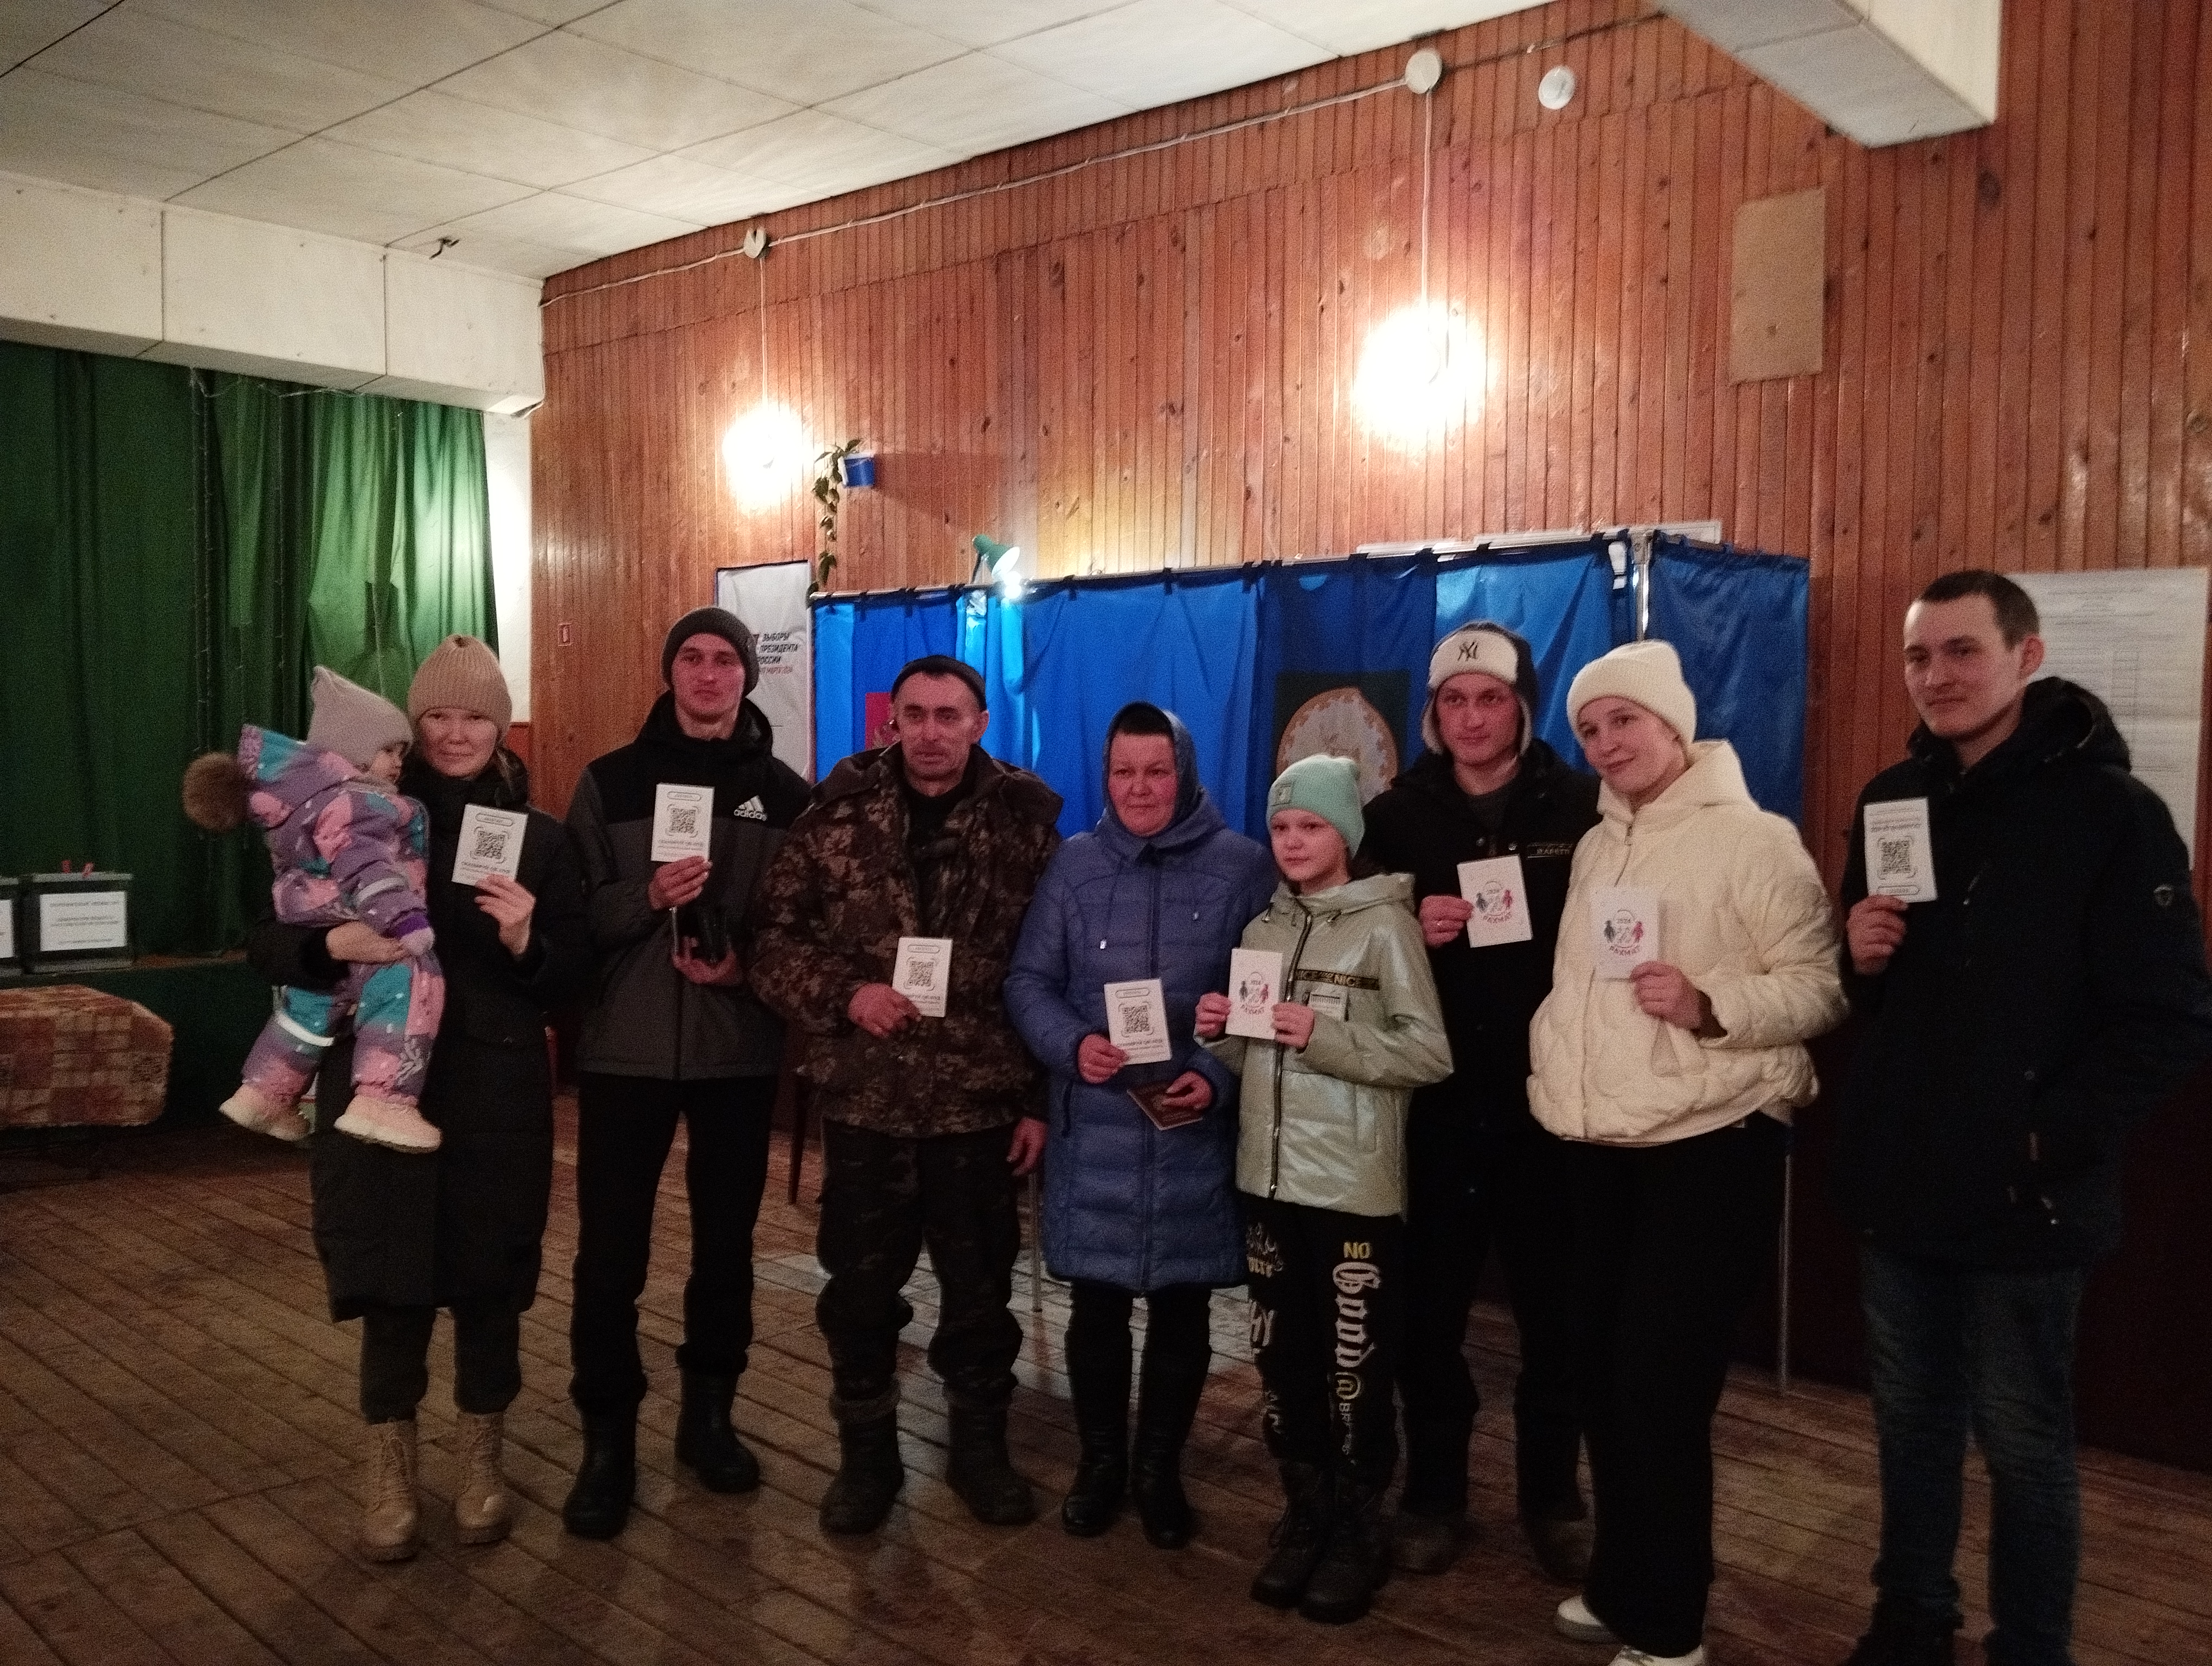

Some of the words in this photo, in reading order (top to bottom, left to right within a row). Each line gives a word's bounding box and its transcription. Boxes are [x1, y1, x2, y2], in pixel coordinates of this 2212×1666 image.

[762, 632, 790, 642] ВЫБОРЫ
[759, 644, 798, 653] ПРЕЗИДЕНТА
[1457, 641, 1478, 662] NY
[1343, 1242, 1371, 1259] NO
